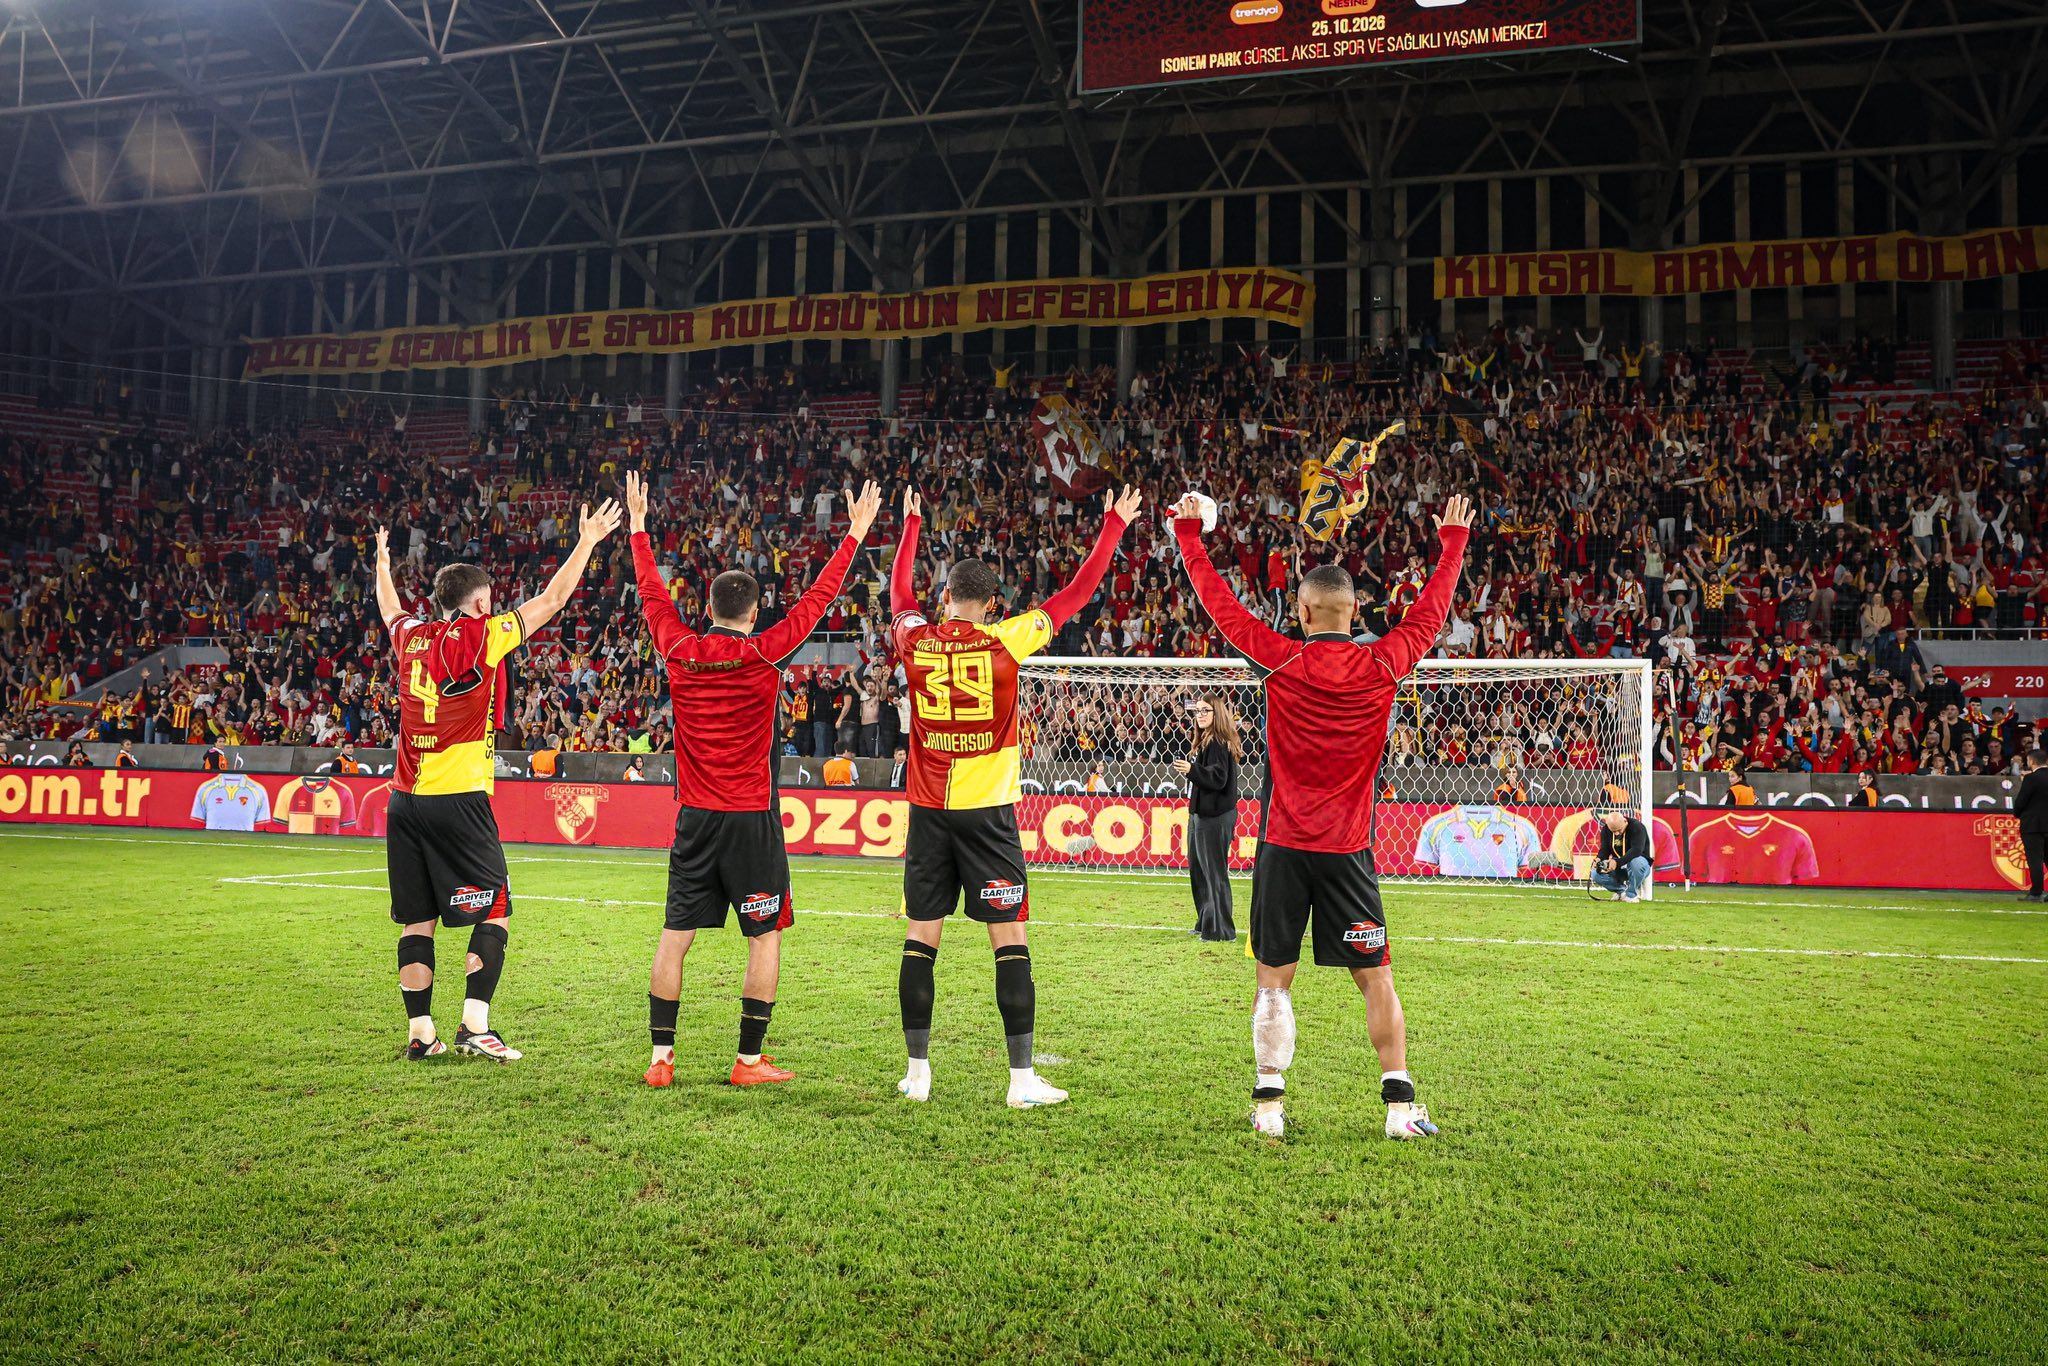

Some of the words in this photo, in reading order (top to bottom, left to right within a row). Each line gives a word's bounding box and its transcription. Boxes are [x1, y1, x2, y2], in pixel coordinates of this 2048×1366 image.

[1235, 5, 1279, 18] trendyol
[1311, 15, 1386, 37] 25.10.2026
[1161, 56, 1207, 74] ISONEM
[1209, 52, 1242, 69] PARK
[1244, 46, 1289, 65] GÜRSEL
[1291, 43, 1331, 61] AKSEL
[1333, 39, 1365, 57] SPOR
[1367, 37, 1385, 54] VE
[1387, 33, 1440, 52] SAĞLIKLI
[1444, 28, 1489, 48] YAŞAM
[1492, 20, 1547, 43] MERKEZİ
[1443, 251, 1634, 297] KUTSAL
[1651, 237, 1879, 295] ARMAYA
[1897, 228, 2041, 281] OLAN
[388, 321, 531, 367] GENÇLİK
[546, 316, 593, 350] VE
[603, 312, 694, 346] SPOR
[710, 291, 960, 341] KULÜBÜ'NÜN
[976, 269, 1305, 323] NEFERLERİYİZ!
[681, 657, 743, 673] GÖZTEPE
[913, 650, 994, 722] 39
[2015, 675, 2044, 688] 220
[409, 659, 440, 724] 4
[922, 731, 994, 752] JANDERSON
[0, 769, 151, 818] om.tr
[451, 891, 492, 904] SARIYER
[982, 886, 1022, 898] SARIYER
[472, 900, 491, 908] KOLA
[742, 897, 779, 912] SARIYER
[1003, 896, 1021, 904] KOLA
[761, 906, 778, 916] KOLA
[1345, 928, 1384, 940] SARIYER
[1368, 939, 1384, 947] KOLA
